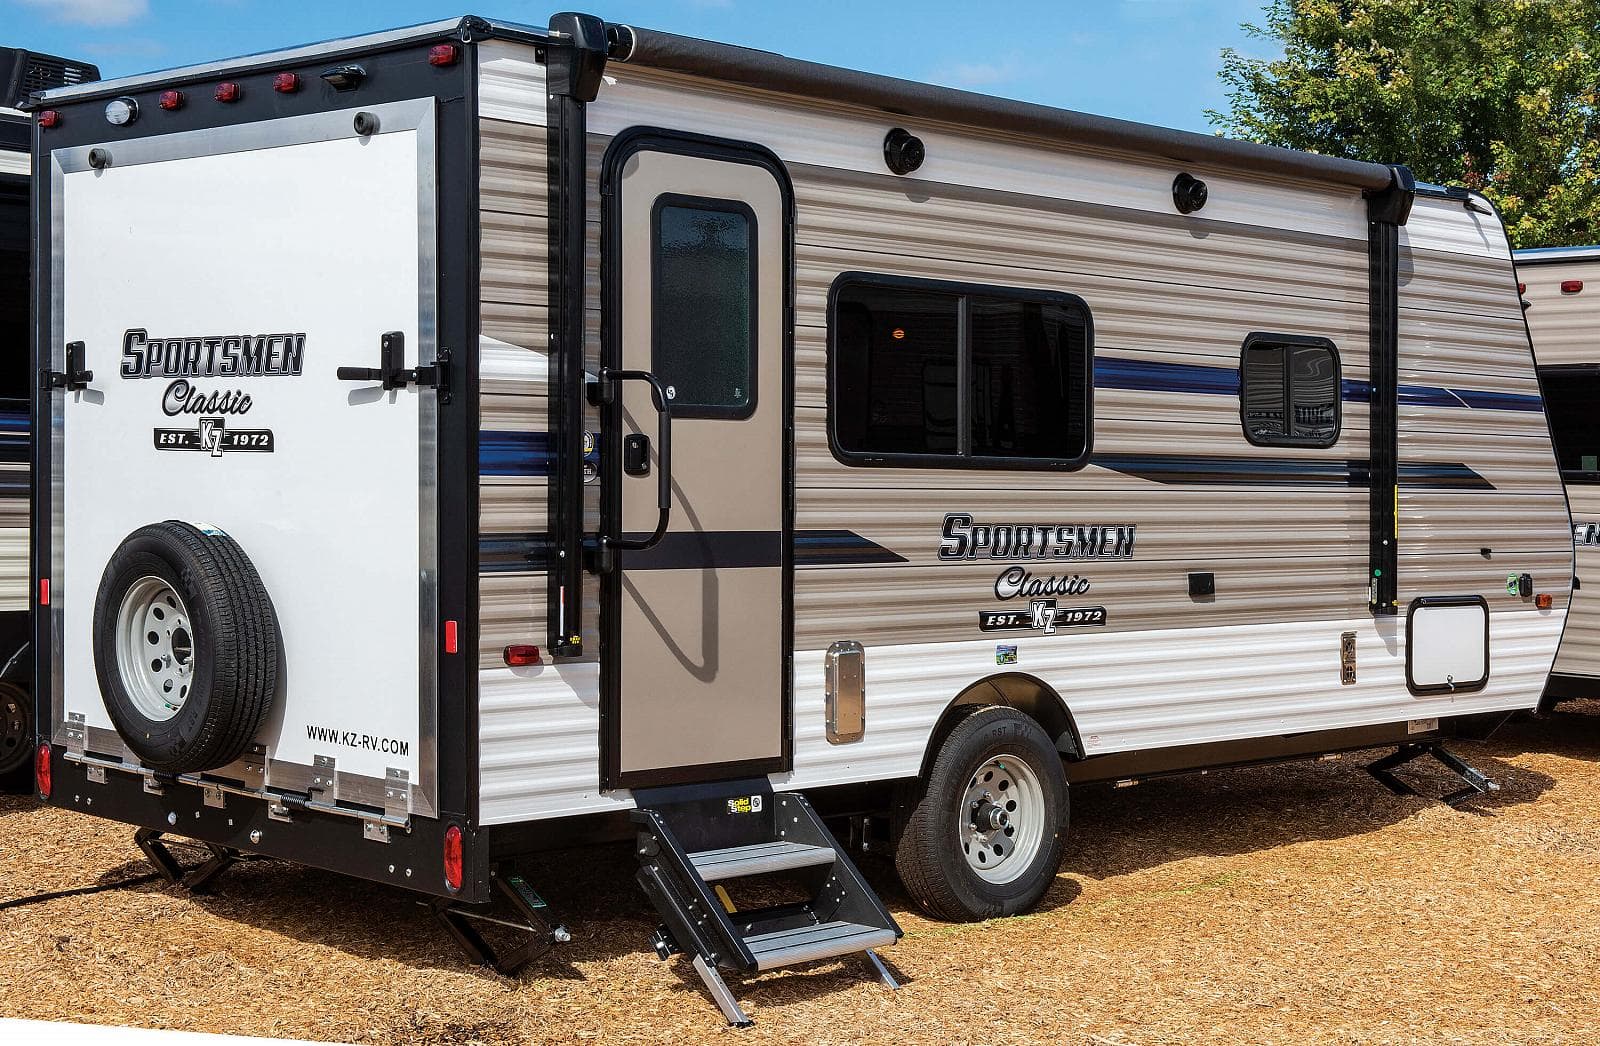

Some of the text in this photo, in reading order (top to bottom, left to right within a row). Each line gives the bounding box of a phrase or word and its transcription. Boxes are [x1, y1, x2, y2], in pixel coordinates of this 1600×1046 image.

[120, 328, 306, 378] SPORTSMEN
[162, 379, 253, 416] Classic
[159, 419, 269, 457] EST. KZ 1972
[938, 512, 1137, 560] SPORTSMEN
[994, 566, 1091, 600] Classic
[986, 600, 1102, 634] EST. KZ 1972
[306, 724, 409, 757] WWW.KZ-RV.COM
[727, 797, 750, 807] Solid
[730, 804, 752, 814] Step
